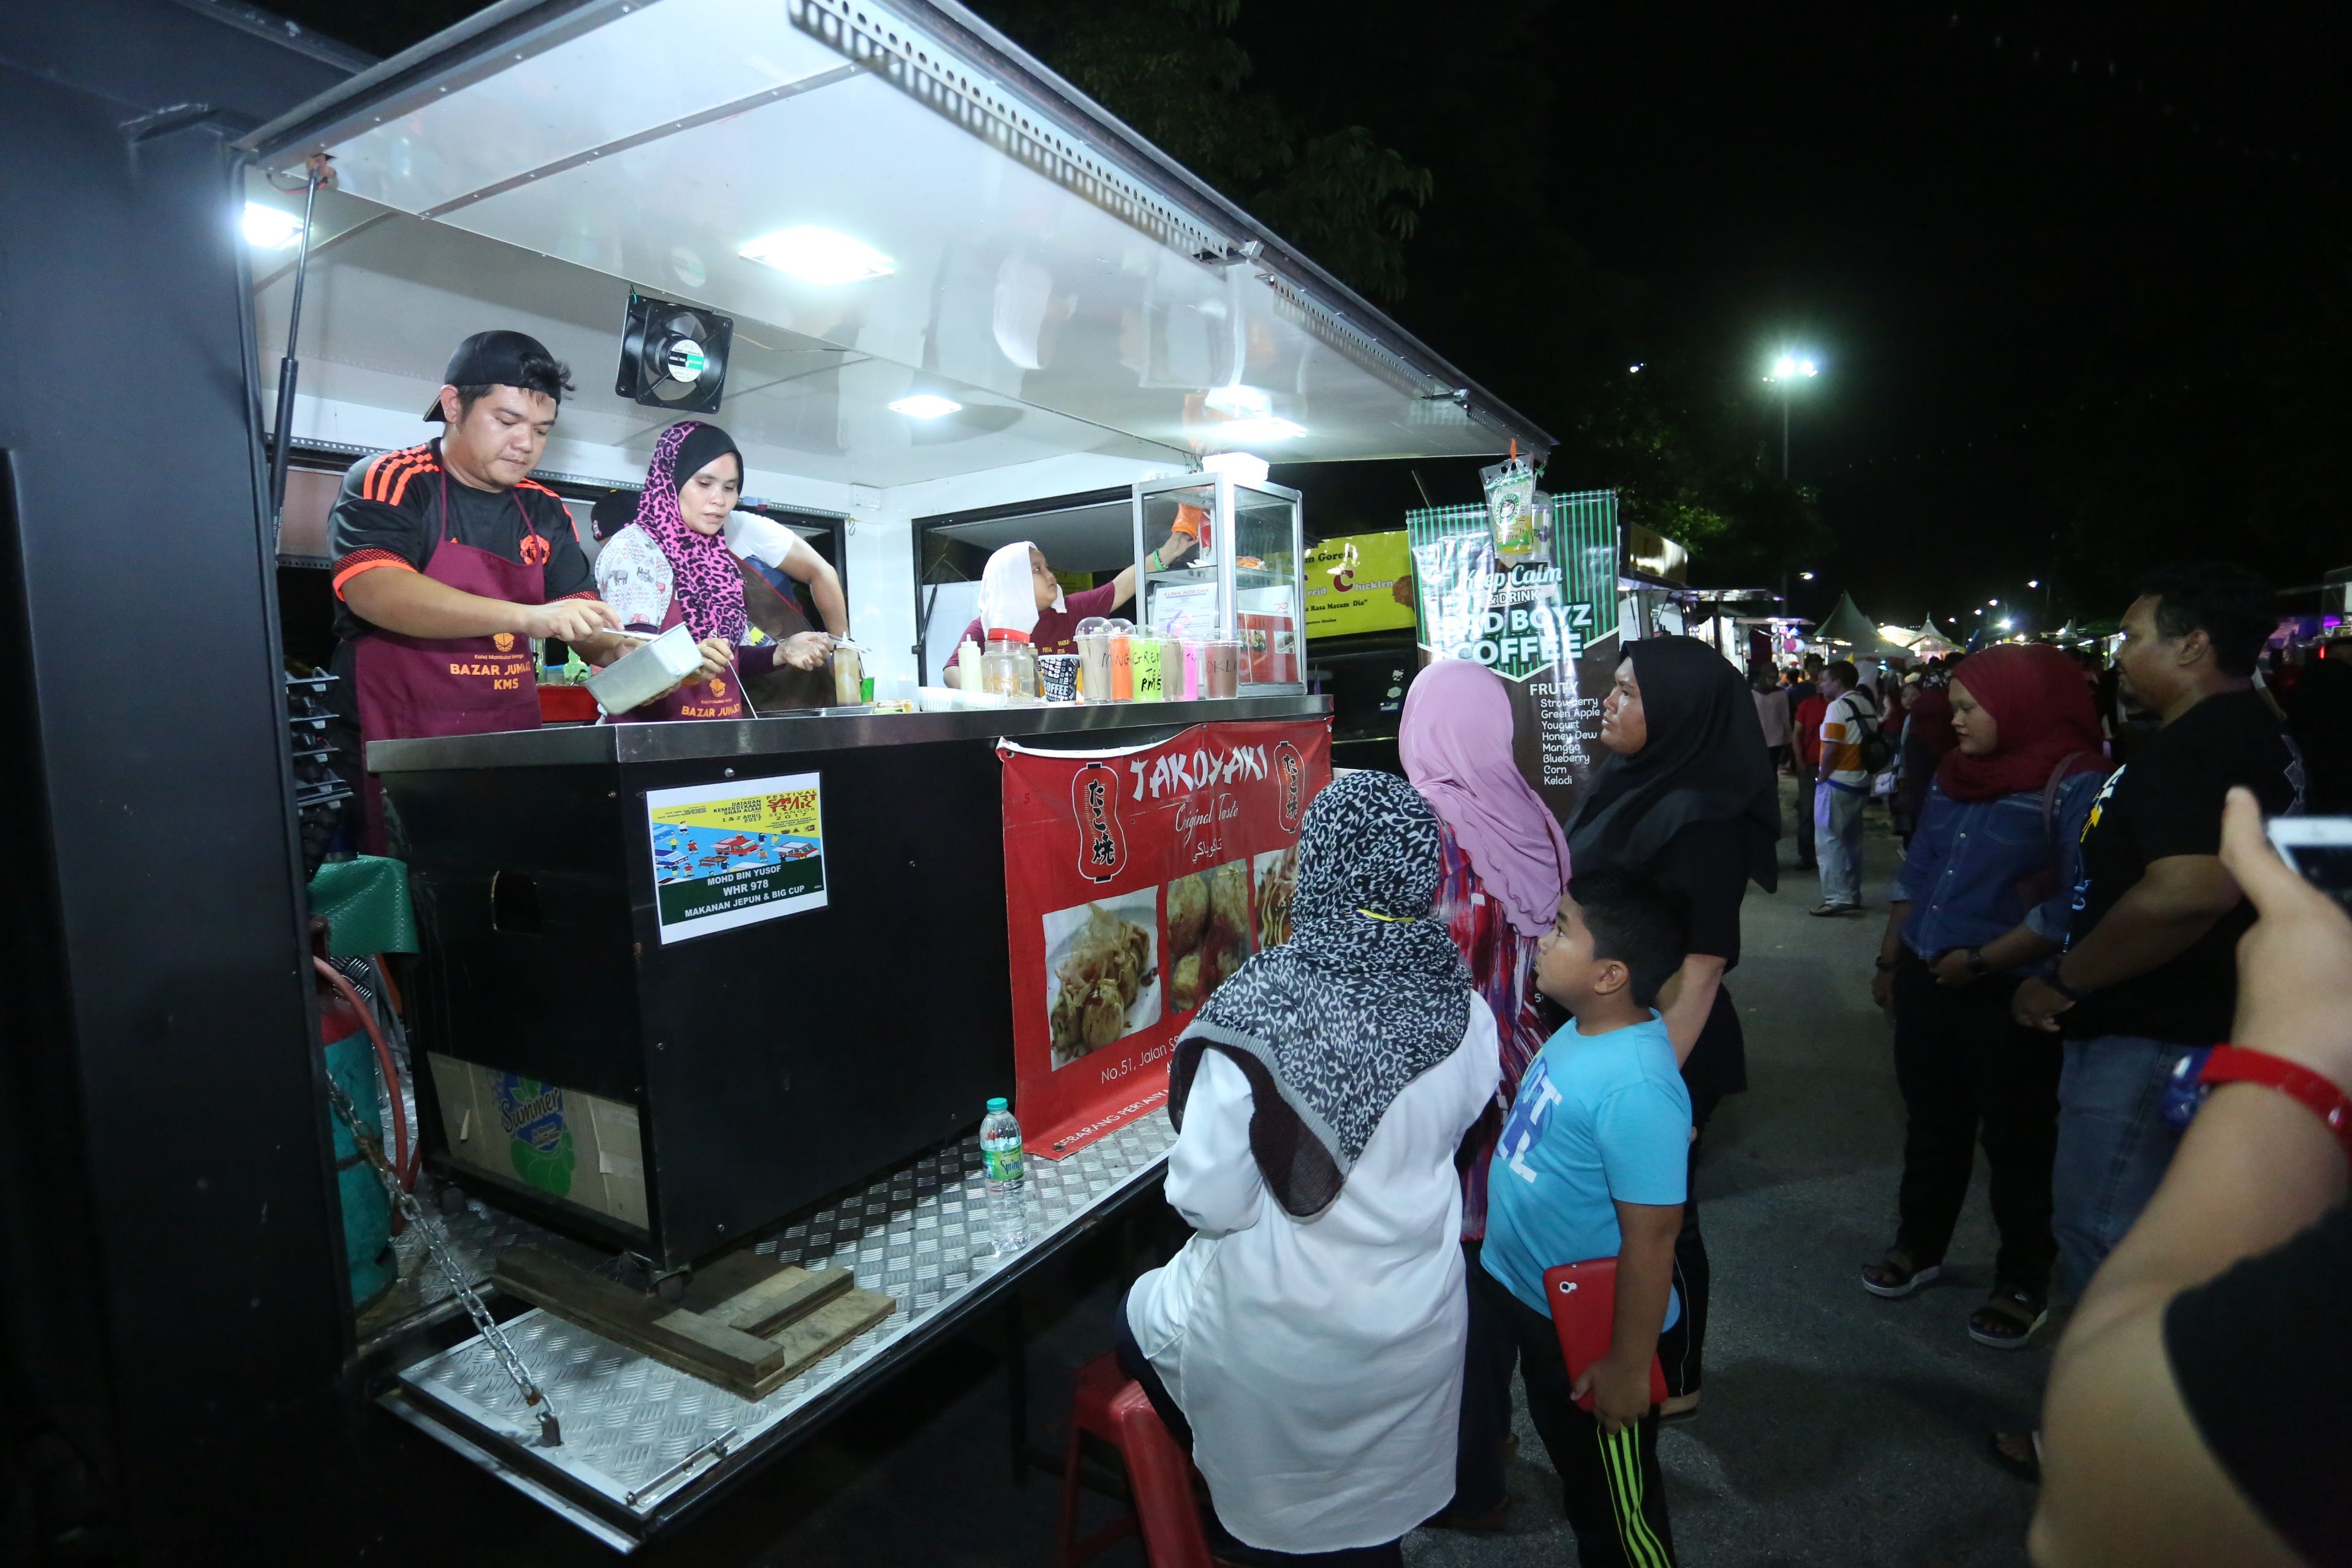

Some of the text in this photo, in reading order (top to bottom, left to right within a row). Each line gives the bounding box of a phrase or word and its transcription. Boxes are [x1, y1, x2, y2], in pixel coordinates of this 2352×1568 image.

[1512, 564, 1562, 587] Calm
[1499, 589, 1541, 604] DRINK
[1511, 603, 1593, 632] BOYZ
[1452, 632, 1583, 666] COFFEE
[450, 661, 531, 676] BAZAR JUMAAT
[494, 678, 519, 690] KMS
[1141, 677, 1161, 692] RM5
[1529, 682, 1578, 696] FRUTY
[1540, 698, 1598, 708] Strawberry
[681, 705, 715, 717] BAZAR
[1541, 707, 1600, 720] Green Apple
[1542, 720, 1580, 732] Yougurt
[1542, 730, 1597, 742] Honey Dew
[1543, 743, 1580, 755] Manggo
[1543, 753, 1590, 765] Blueberry
[1129, 744, 1268, 802] TAKOYAKI
[1544, 765, 1567, 774] Corn
[1544, 775, 1572, 785] Keladi
[766, 790, 817, 800] FESTIVAL
[714, 804, 761, 813] KEMERDEKAAN
[769, 808, 815, 818] SELANGOR
[1088, 778, 1115, 866] たこ焼
[1175, 793, 1239, 848] Original Taste
[707, 865, 782, 886] MOHD BIN YUSOF
[723, 879, 769, 897] WHR 978
[685, 901, 731, 918] MAKANAN
[733, 894, 761, 907] JEPUN
[772, 889, 786, 899] BIG
[788, 885, 805, 895] CUP
[1101, 1057, 1136, 1084] No.51,
[1139, 1044, 1167, 1066] Jalan
[501, 1087, 559, 1133] Summer
[1000, 1154, 1022, 1175] Spring
